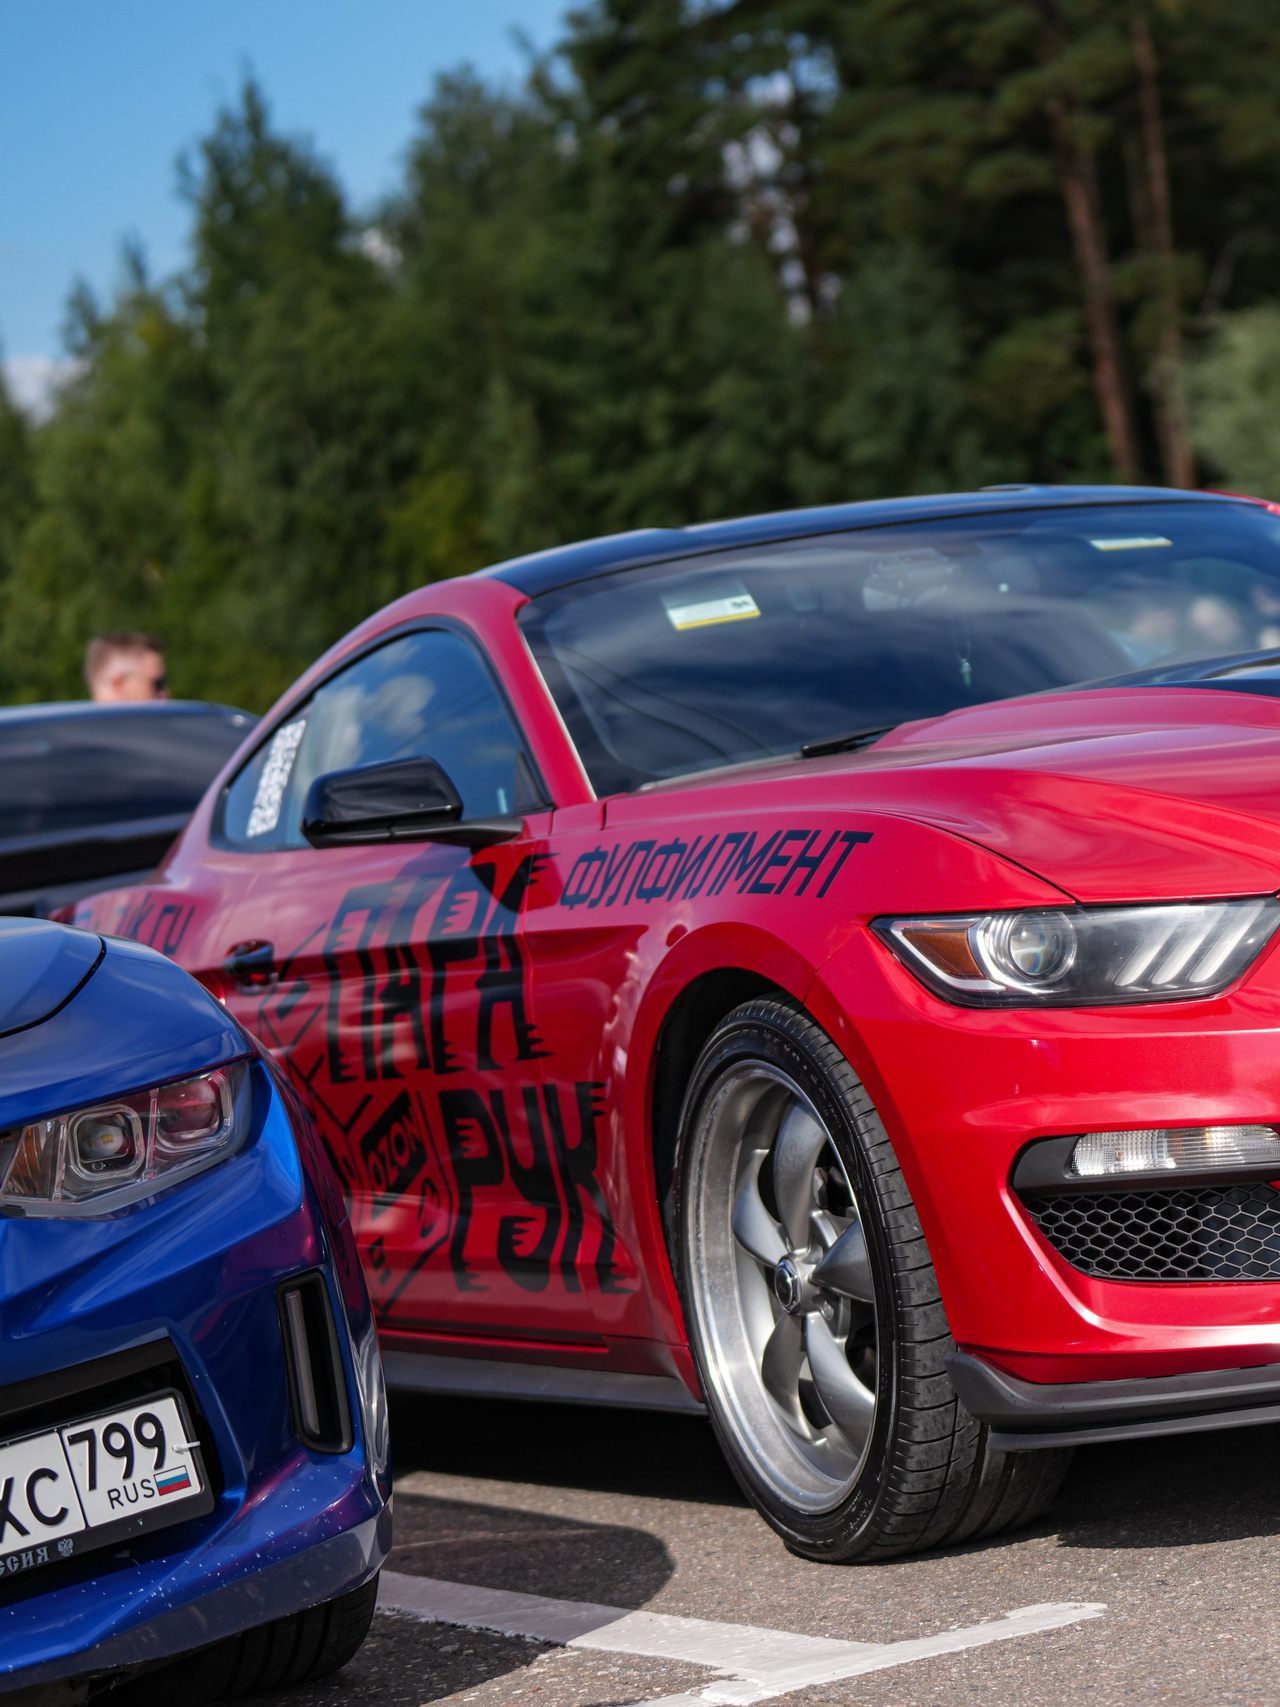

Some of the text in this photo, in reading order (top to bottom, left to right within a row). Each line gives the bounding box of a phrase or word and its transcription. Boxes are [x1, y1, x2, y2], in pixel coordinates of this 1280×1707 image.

[560, 830, 874, 910] ФУЛФИЛМЕНТ
[367, 1106, 424, 1198] OZON
[67, 1412, 167, 1491] 799
[107, 1479, 155, 1509] RUS
